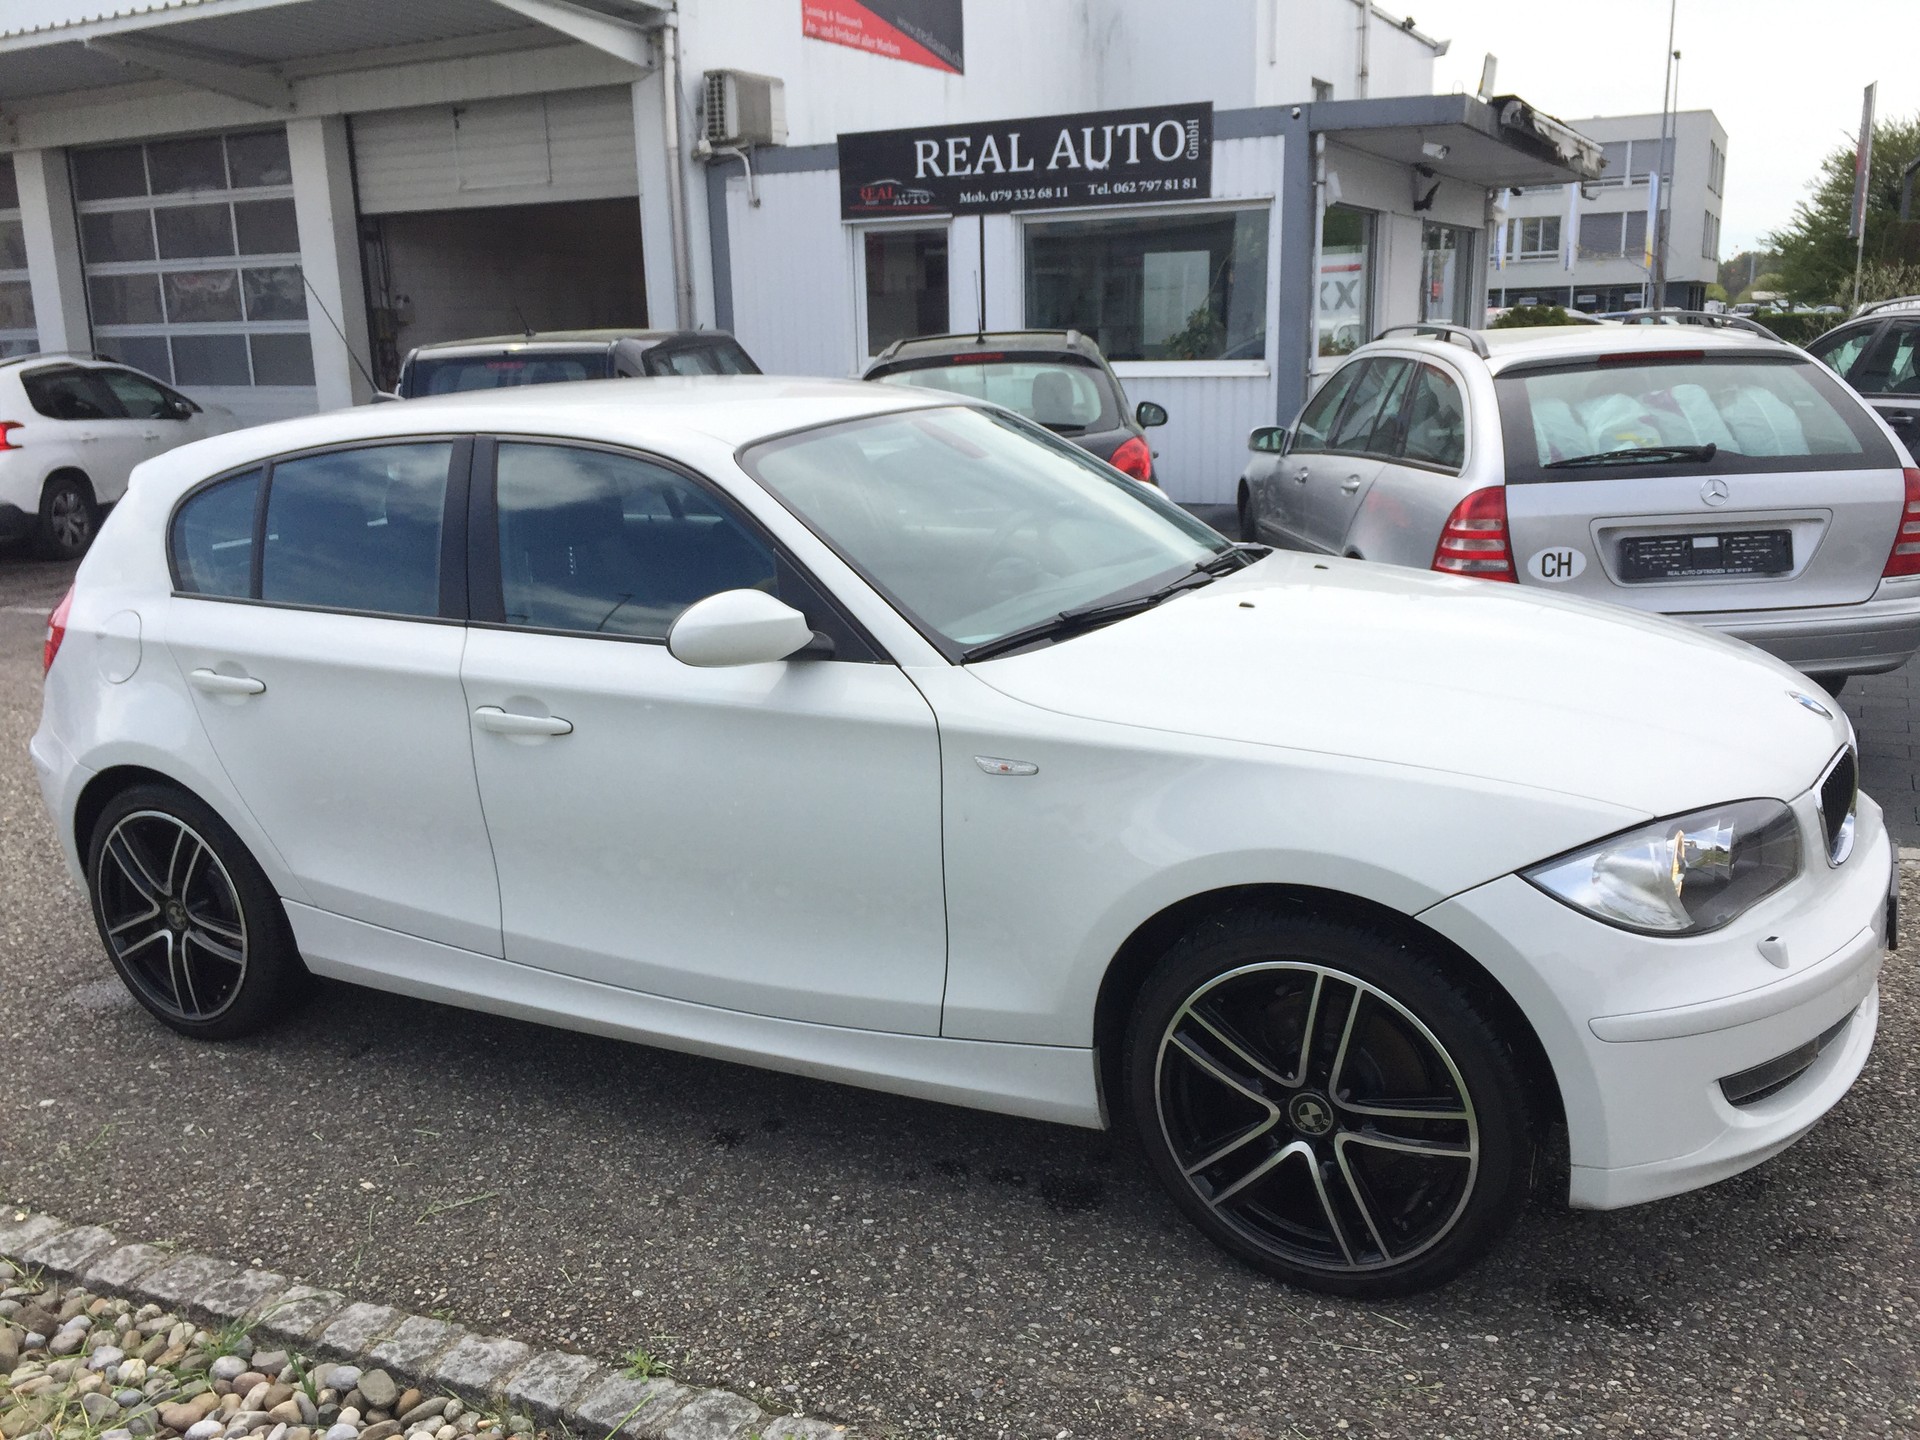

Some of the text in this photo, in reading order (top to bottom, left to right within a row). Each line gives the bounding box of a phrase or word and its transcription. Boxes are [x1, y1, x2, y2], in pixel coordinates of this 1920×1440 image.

[914, 119, 1186, 178] REAL AUTO
[1185, 119, 1200, 161] GmbH
[959, 186, 1069, 204] Mob. 079 332 68 11
[1087, 177, 1198, 196] Tel. 062 797 81 81
[892, 192, 931, 206] AUTO
[1541, 552, 1573, 578] CH
